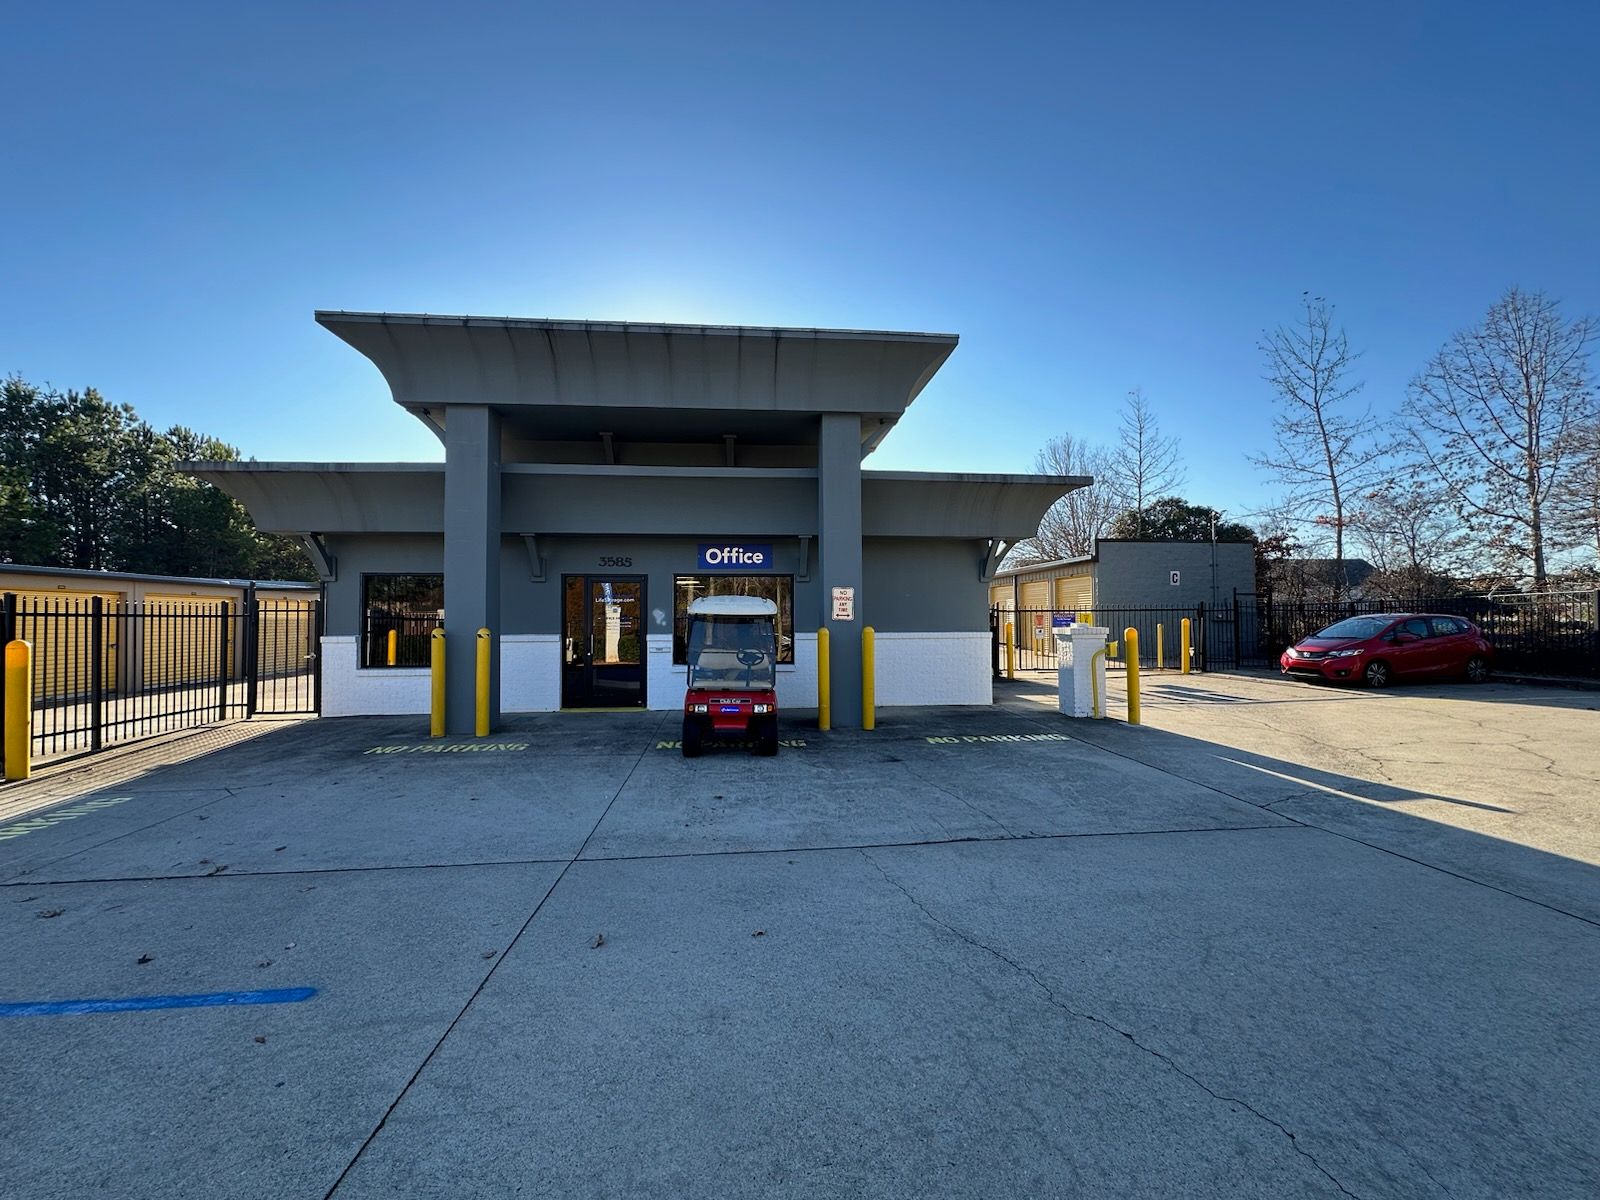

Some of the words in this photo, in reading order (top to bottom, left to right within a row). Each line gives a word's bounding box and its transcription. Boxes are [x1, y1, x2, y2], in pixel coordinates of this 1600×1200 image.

[705, 547, 764, 564] Office
[598, 556, 632, 567] 3585
[1172, 573, 1178, 583] C
[926, 736, 959, 744] NO
[962, 734, 1071, 743] PARKING
[363, 745, 409, 754] NO
[409, 744, 530, 753] PARKING
